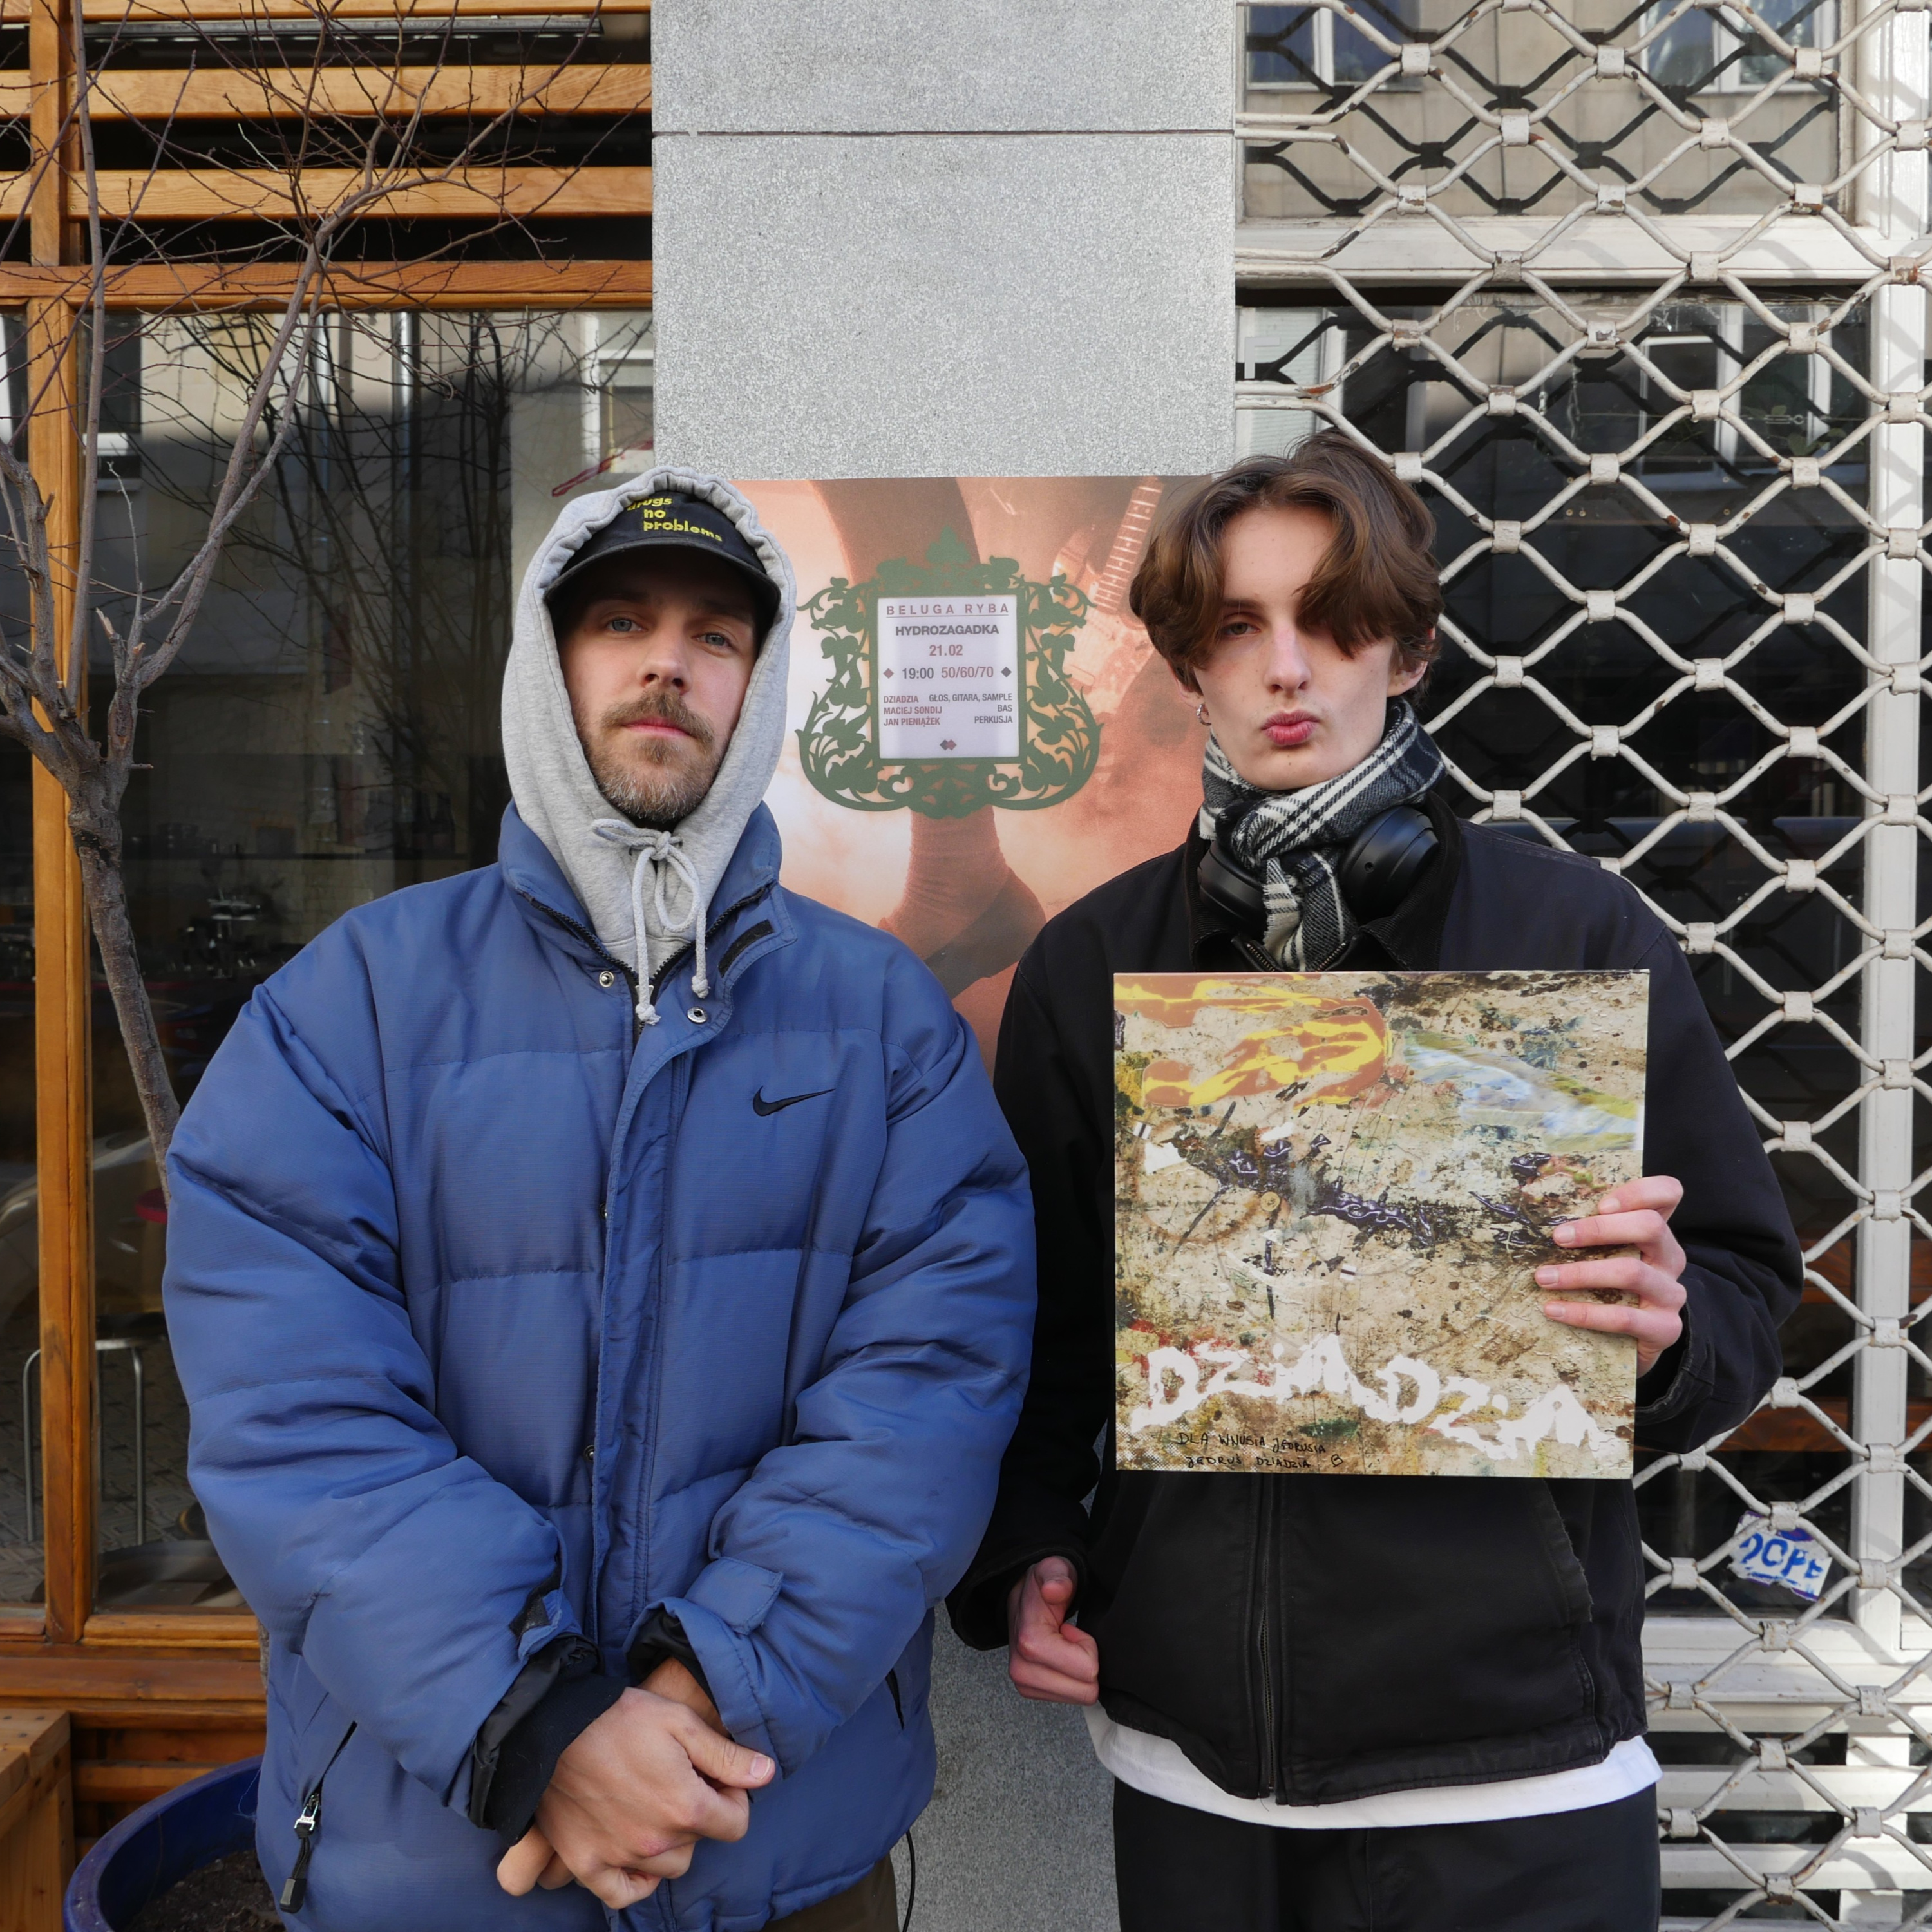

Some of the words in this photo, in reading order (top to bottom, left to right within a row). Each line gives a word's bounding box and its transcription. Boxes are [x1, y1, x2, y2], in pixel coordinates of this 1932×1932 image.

[644, 509, 666, 518] no
[643, 519, 723, 542] problems
[887, 604, 954, 615] BELUGA
[965, 603, 1009, 614] RYBA
[895, 625, 999, 636] HYDROZAGADKA
[929, 644, 963, 656] 21.02
[902, 667, 934, 679] 19:00
[941, 666, 994, 678] 50/60/70
[929, 694, 951, 703] GŁOS,
[952, 694, 980, 702] GITARA,
[982, 693, 1012, 701] SAMPLE
[901, 717, 940, 727] PIENIĄŻEK
[1177, 1432, 1209, 1445] DLA
